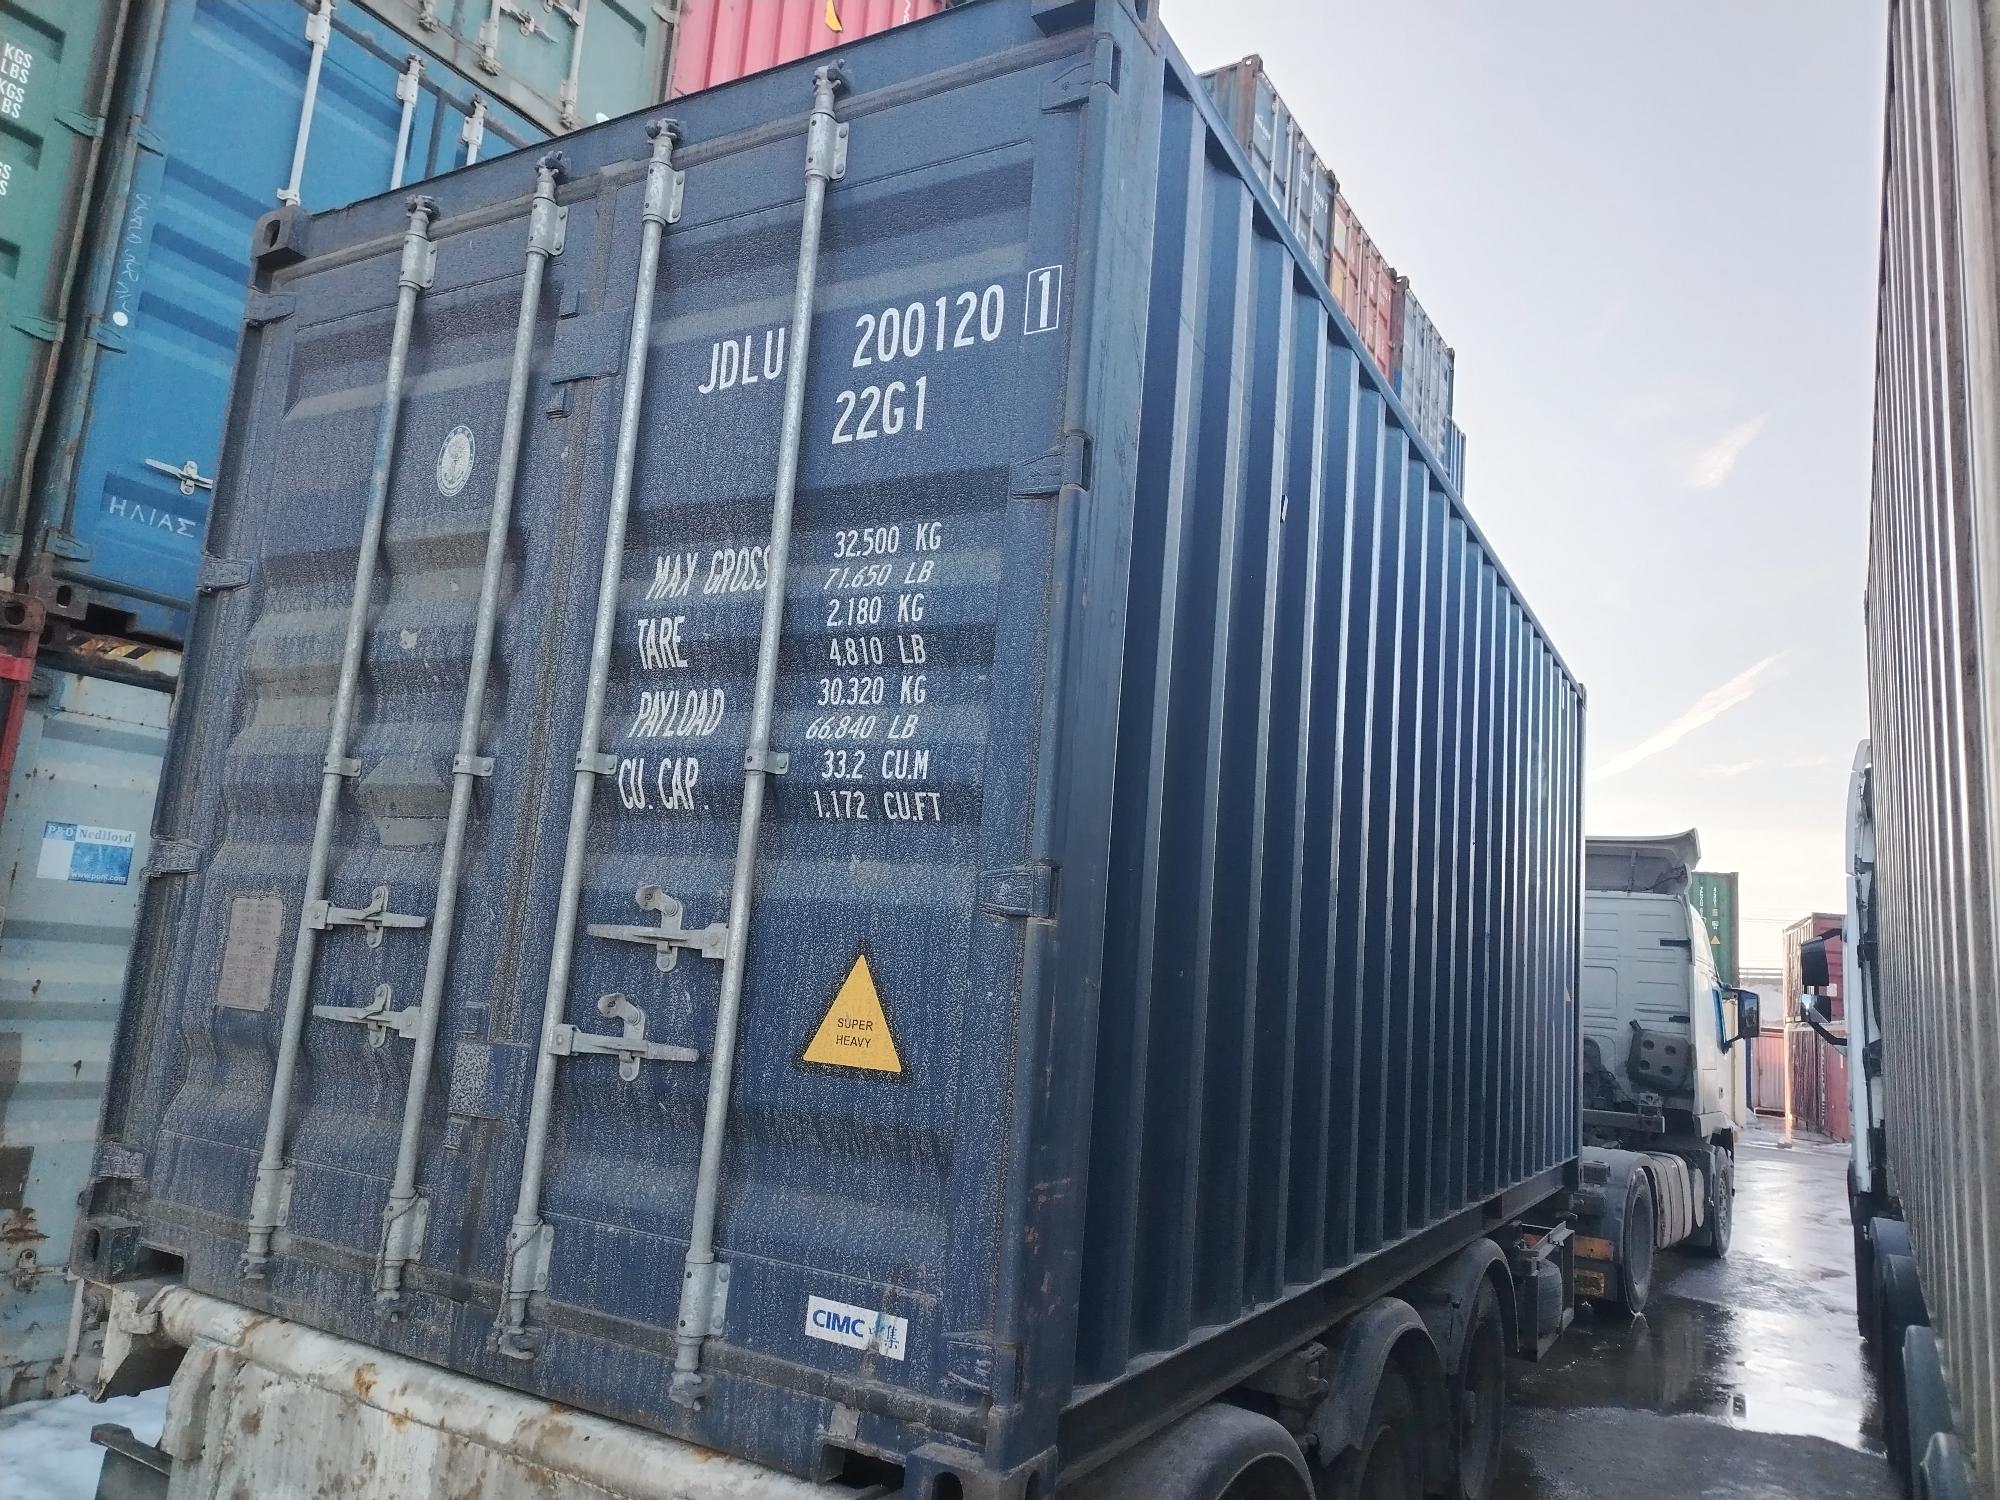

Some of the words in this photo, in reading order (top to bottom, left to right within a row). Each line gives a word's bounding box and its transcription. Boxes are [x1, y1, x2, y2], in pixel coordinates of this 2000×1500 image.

[4, 42, 32, 69] KGS
[1, 58, 29, 84] LBS
[1, 97, 21, 119] BS
[698, 327, 785, 394] JDLU
[852, 284, 1005, 368] 200120
[831, 376, 927, 445] 22G1
[645, 551, 699, 600] MAX
[915, 521, 942, 551] KG
[903, 560, 935, 584] LB
[637, 615, 688, 670] TARE
[897, 592, 925, 622] KG
[897, 634, 926, 664] LB
[627, 687, 725, 739] PAYLOAD
[900, 674, 927, 704] KG
[887, 714, 919, 739] LB
[618, 757, 654, 810] CU.
[821, 748, 866, 779] 33.2
[79, 829, 133, 845] Nedlloyd
[837, 1017, 874, 1032] SUPER
[835, 1034, 872, 1049] HEAVY
[812, 1308, 866, 1338] CIMC
[868, 1324, 900, 1350] 集
